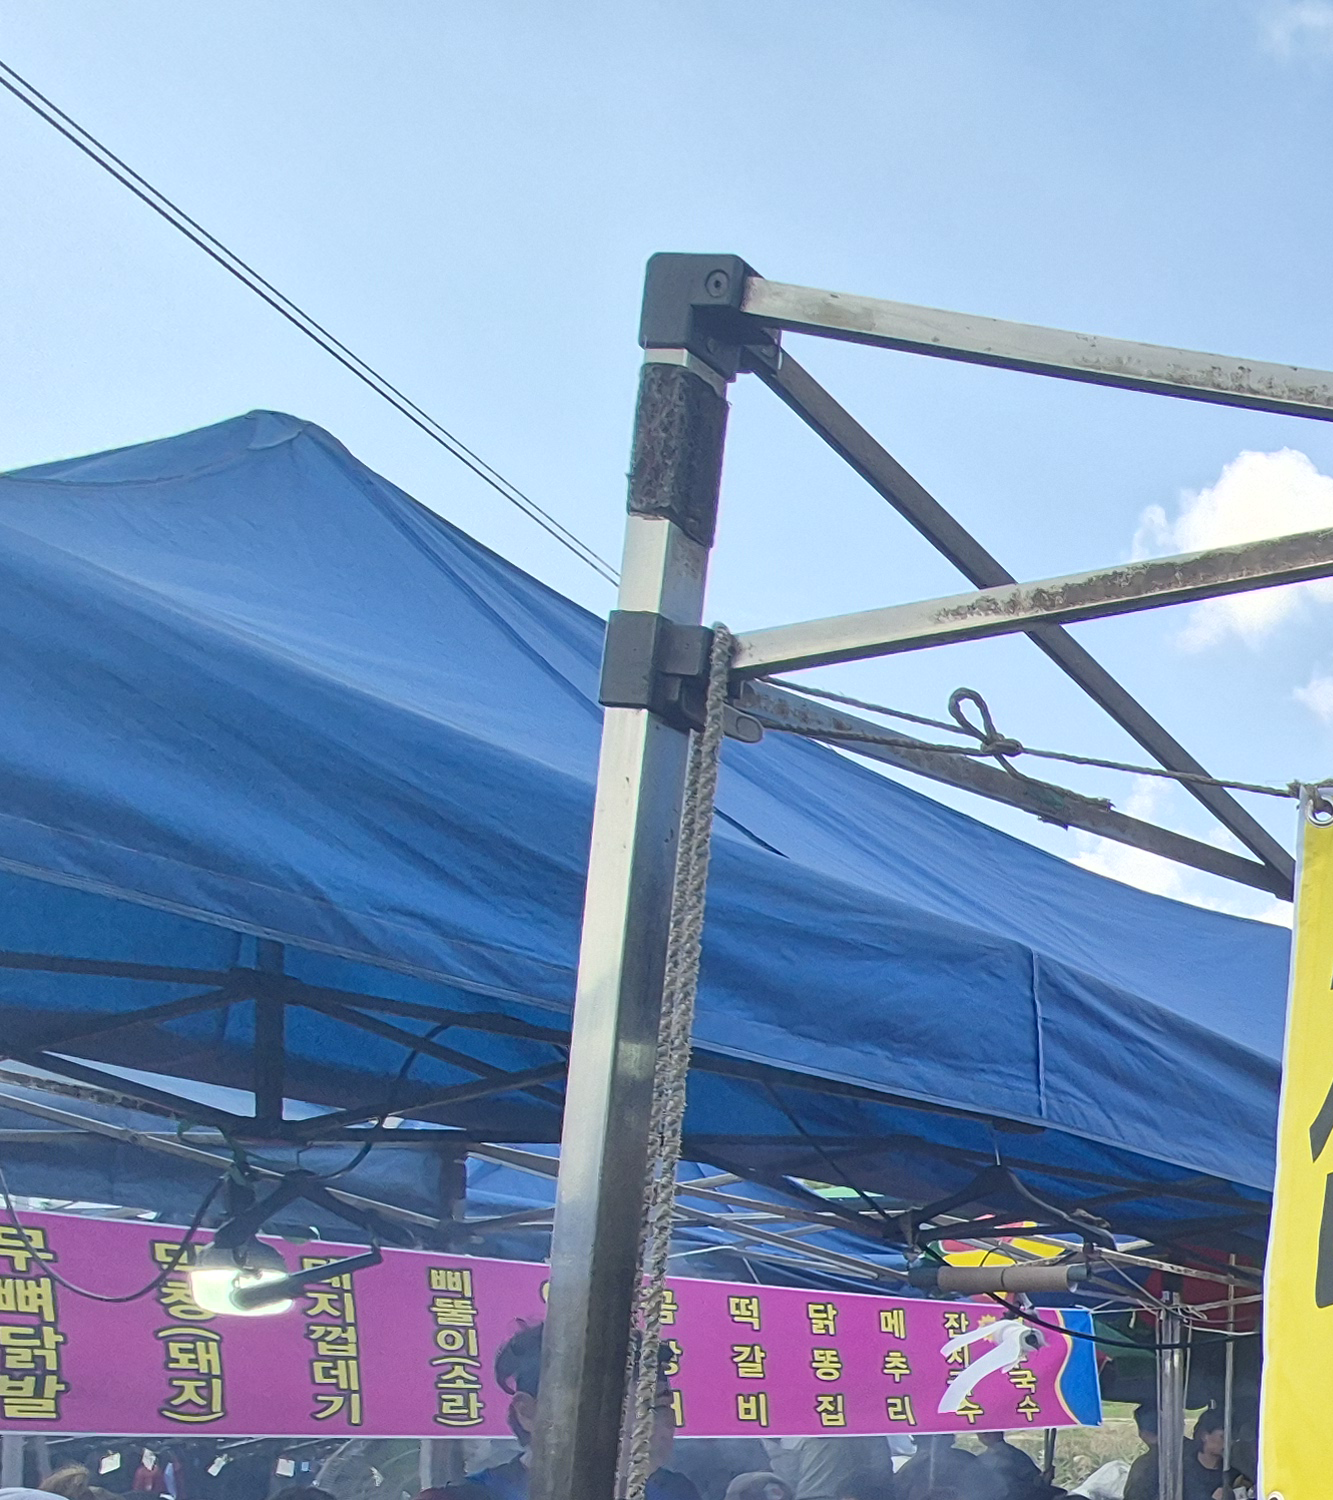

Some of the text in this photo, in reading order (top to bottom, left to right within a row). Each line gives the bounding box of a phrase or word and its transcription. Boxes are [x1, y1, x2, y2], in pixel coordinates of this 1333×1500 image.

[0, 1225, 70, 1421] 무뼈닭발
[428, 1267, 486, 1427] 삐뚤이(소라)
[727, 1296, 769, 1427] 떡갈비
[806, 1302, 847, 1427] 닭똥집
[879, 1308, 918, 1426] 메추리
[943, 1312, 984, 1424] 잔치수
